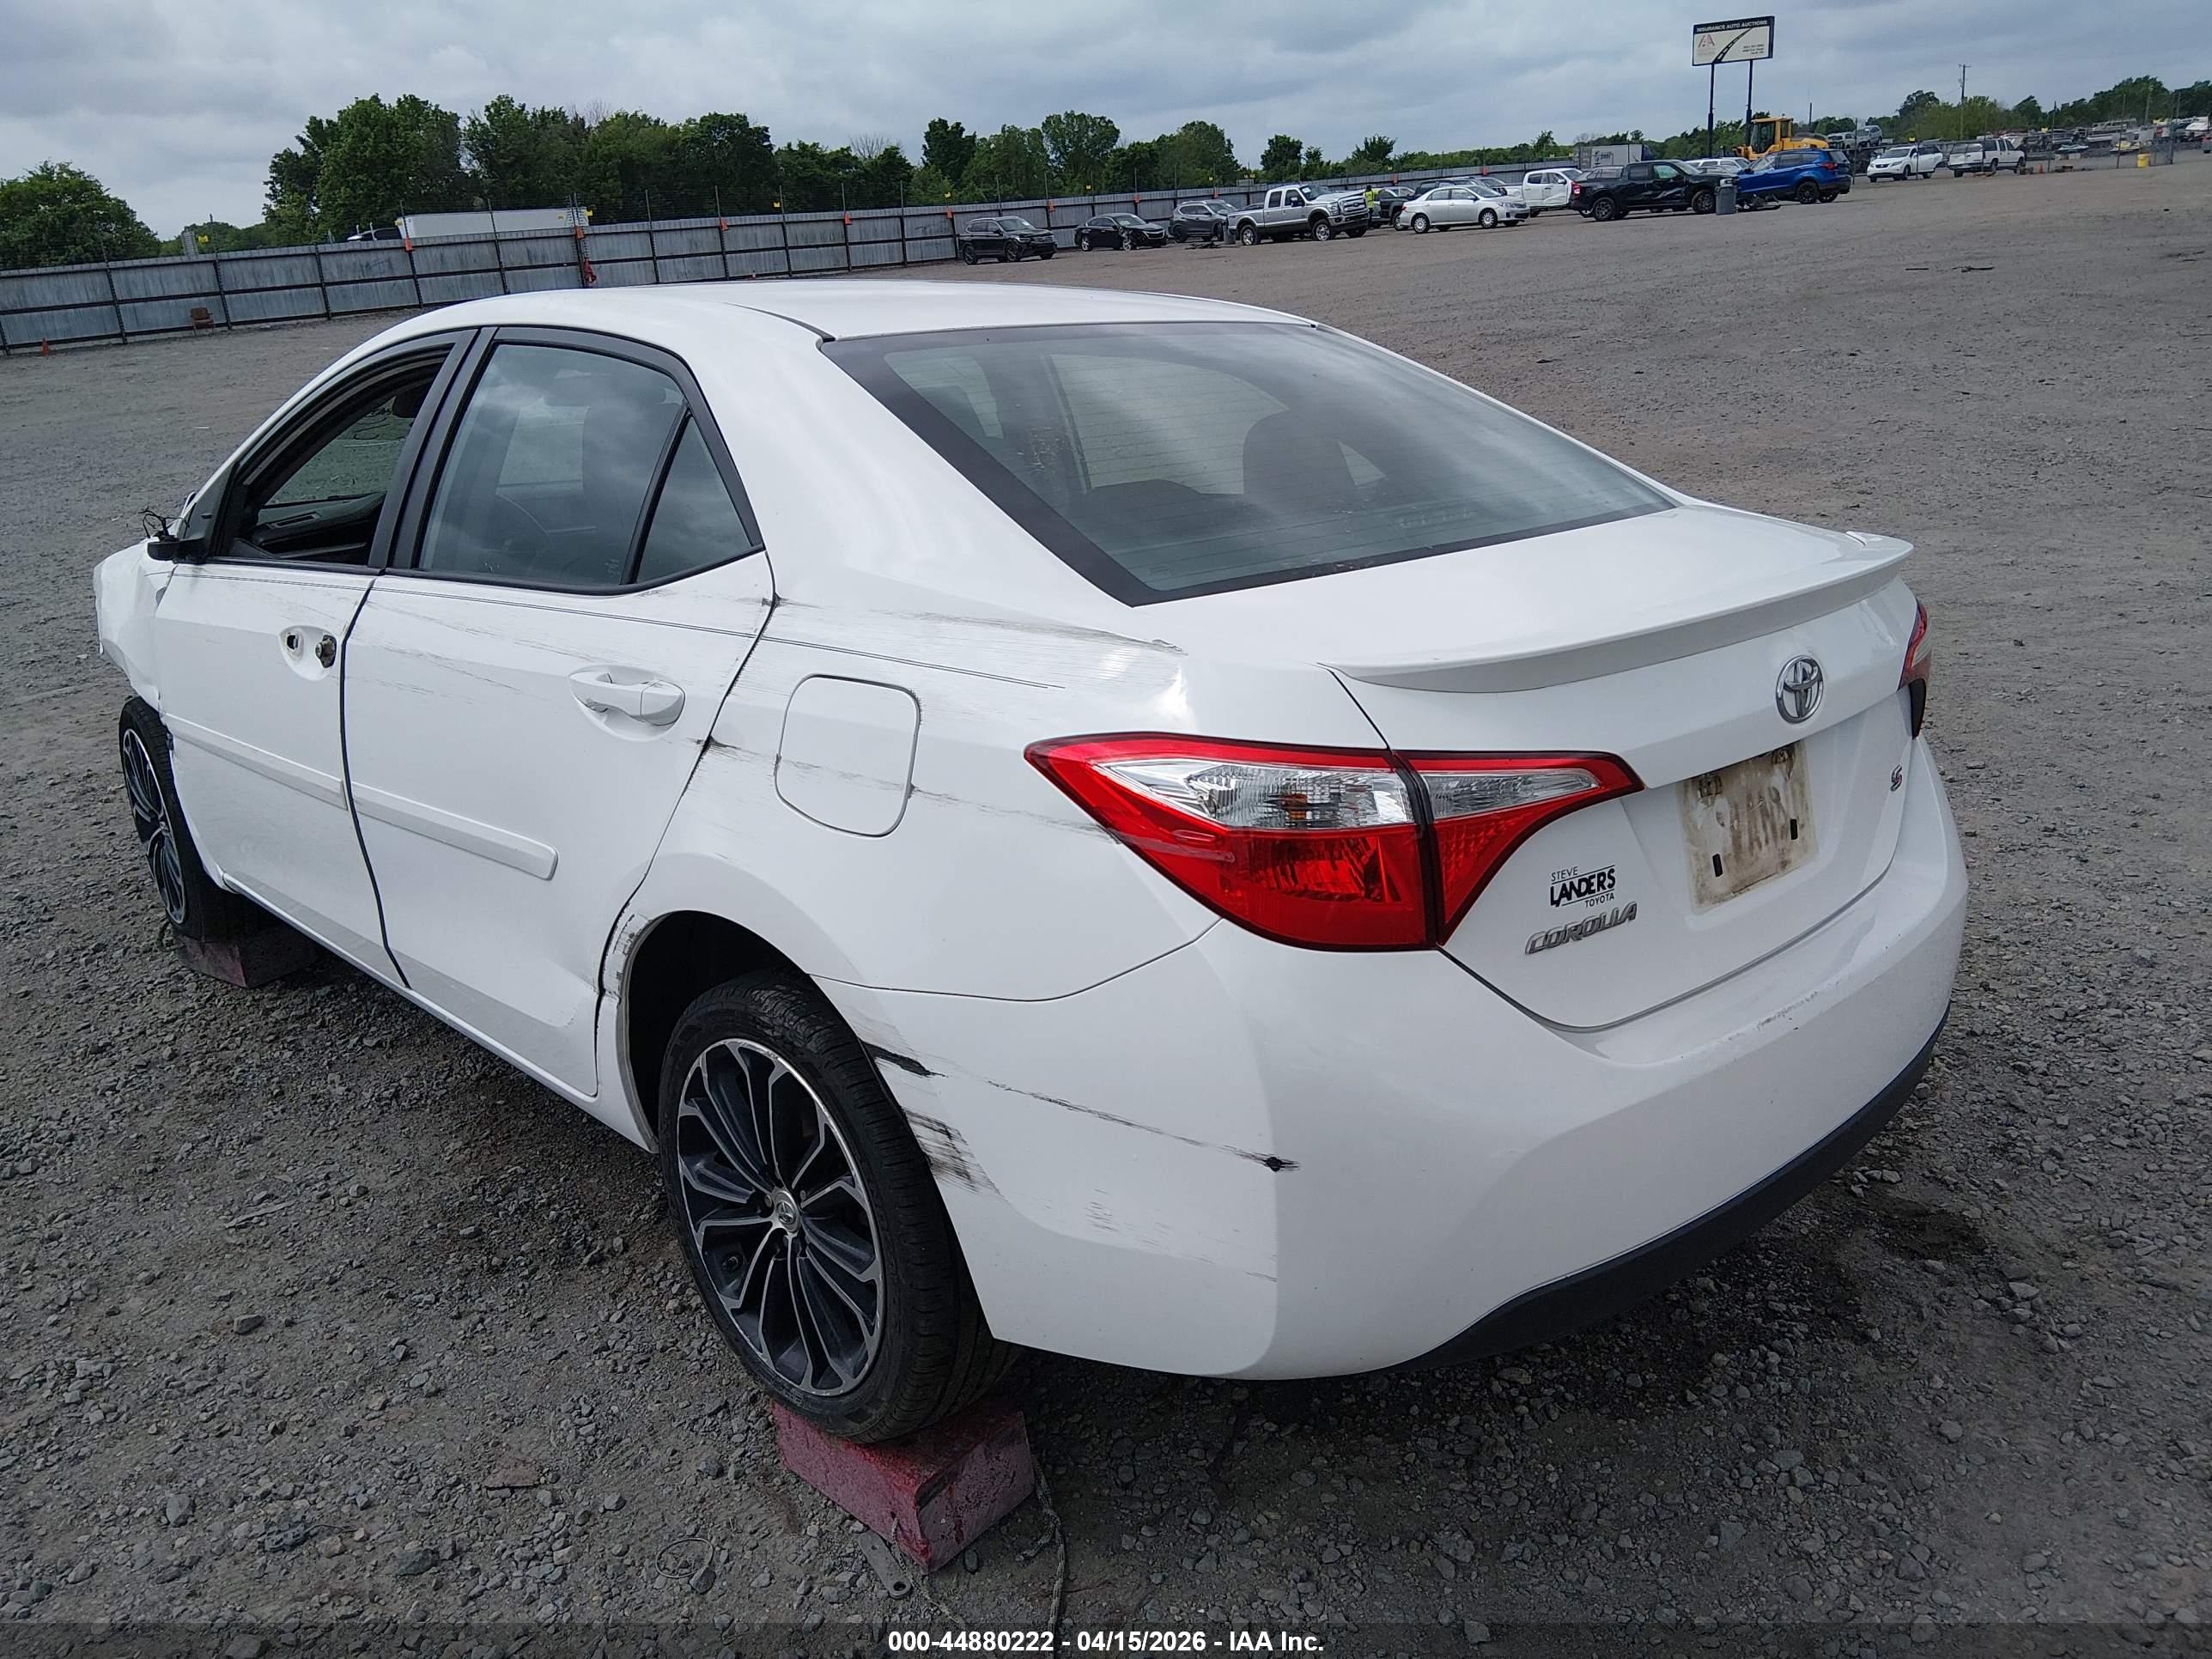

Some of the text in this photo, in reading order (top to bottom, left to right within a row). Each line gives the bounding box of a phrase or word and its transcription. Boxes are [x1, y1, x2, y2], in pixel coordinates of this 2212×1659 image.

[1549, 867, 1616, 908] LANDERS
[1551, 866, 1578, 882] STEVE
[1584, 892, 1615, 908] TOYOTA
[1525, 901, 1638, 955] COROLLA
